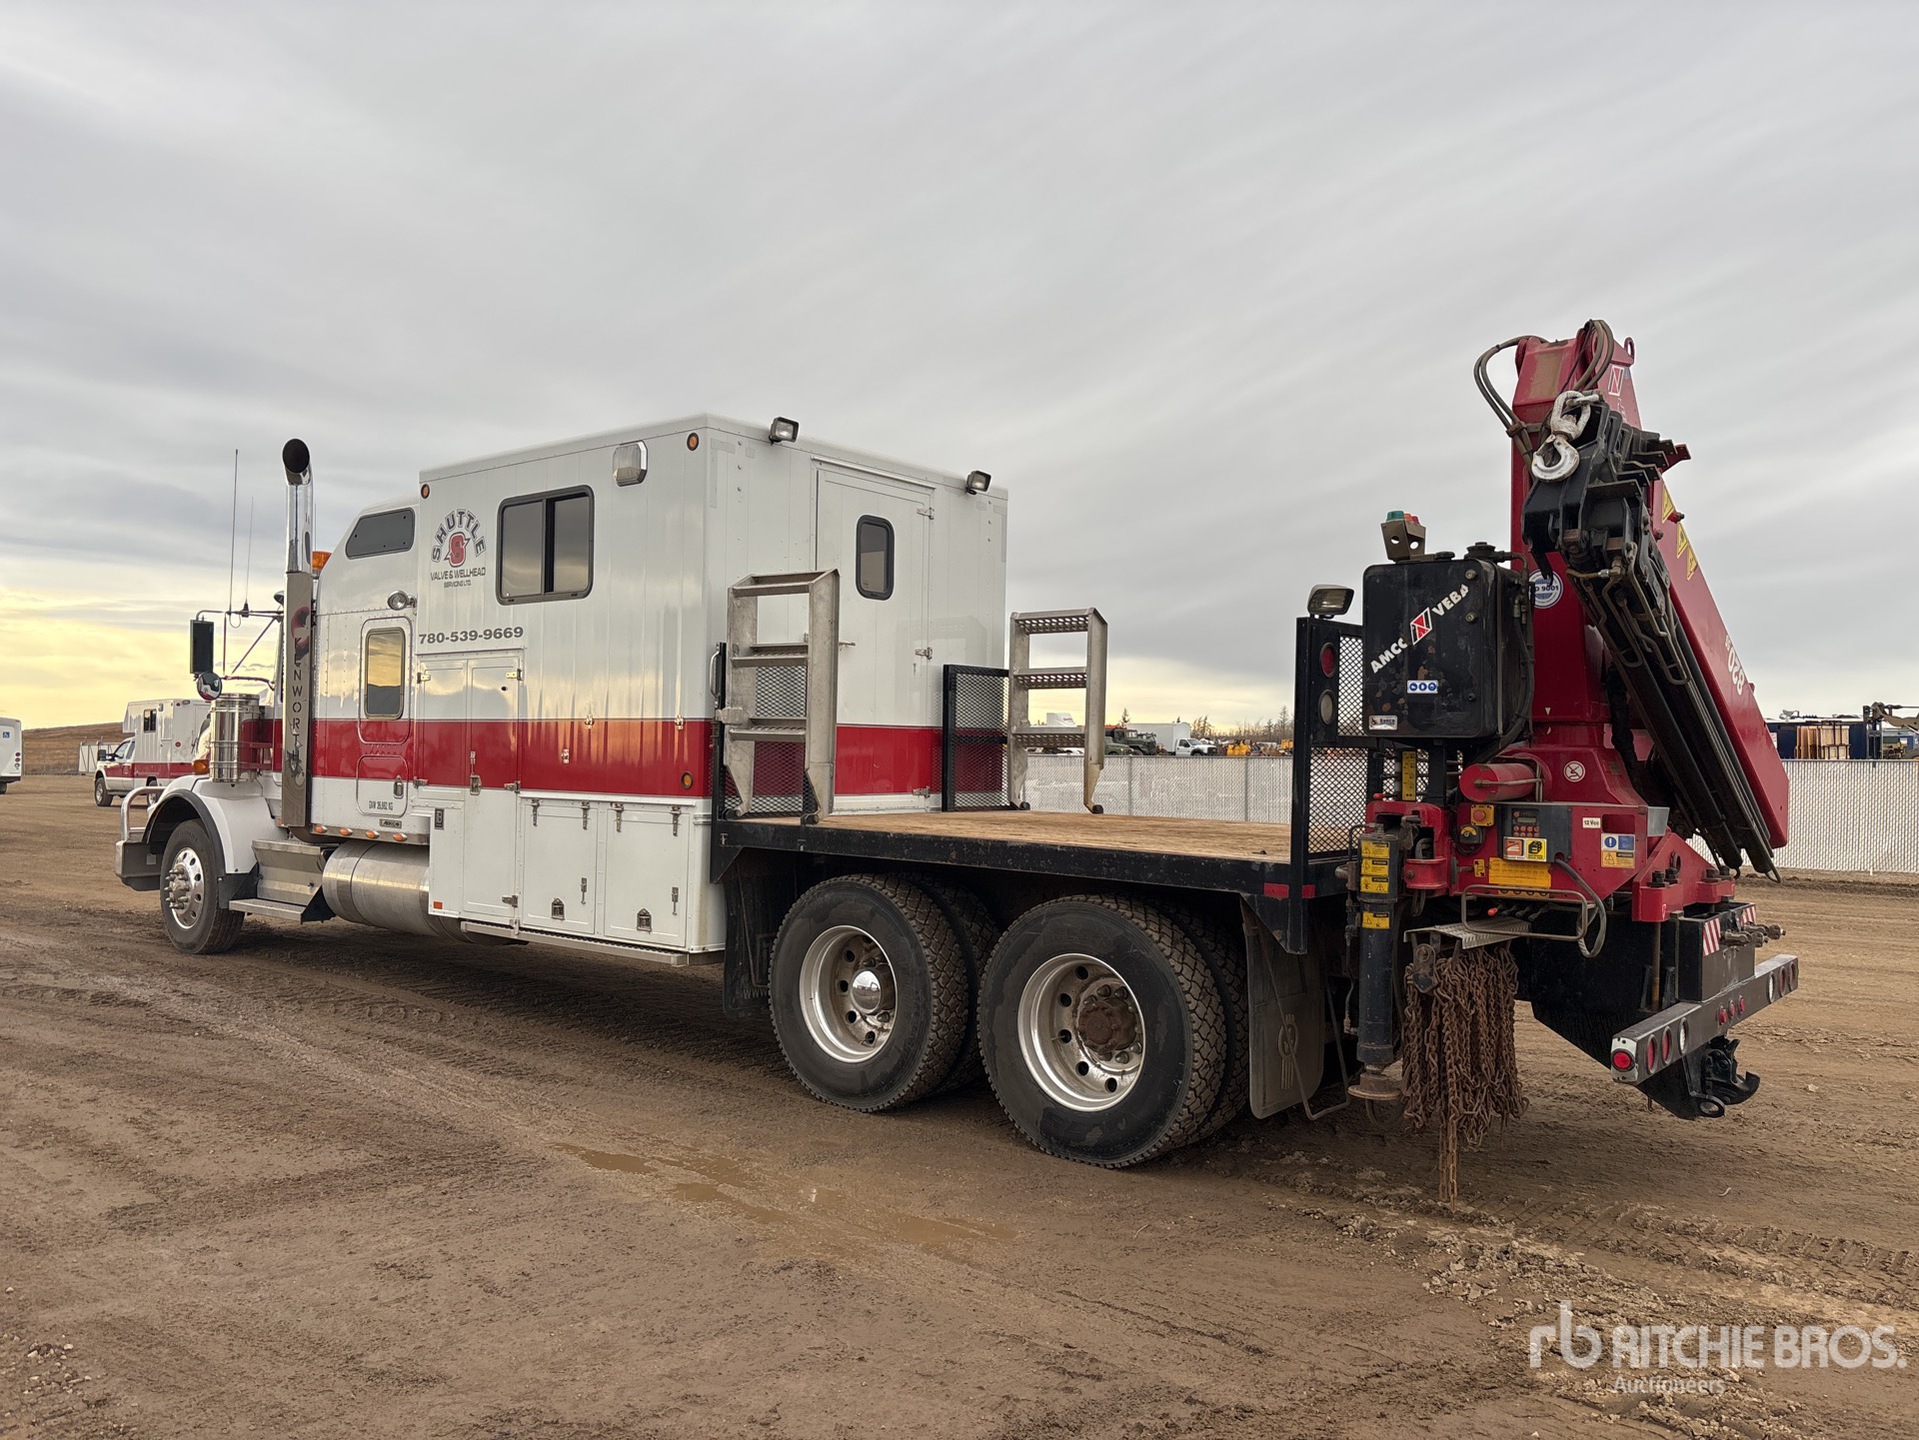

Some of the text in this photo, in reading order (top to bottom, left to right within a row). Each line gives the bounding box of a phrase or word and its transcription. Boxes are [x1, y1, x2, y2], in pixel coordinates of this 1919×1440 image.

[432, 509, 486, 563] SHUTTLE
[430, 566, 486, 581] VALVE & WELLHEAD
[1431, 584, 1469, 616] VEBA
[419, 626, 524, 644] 780-539-9669
